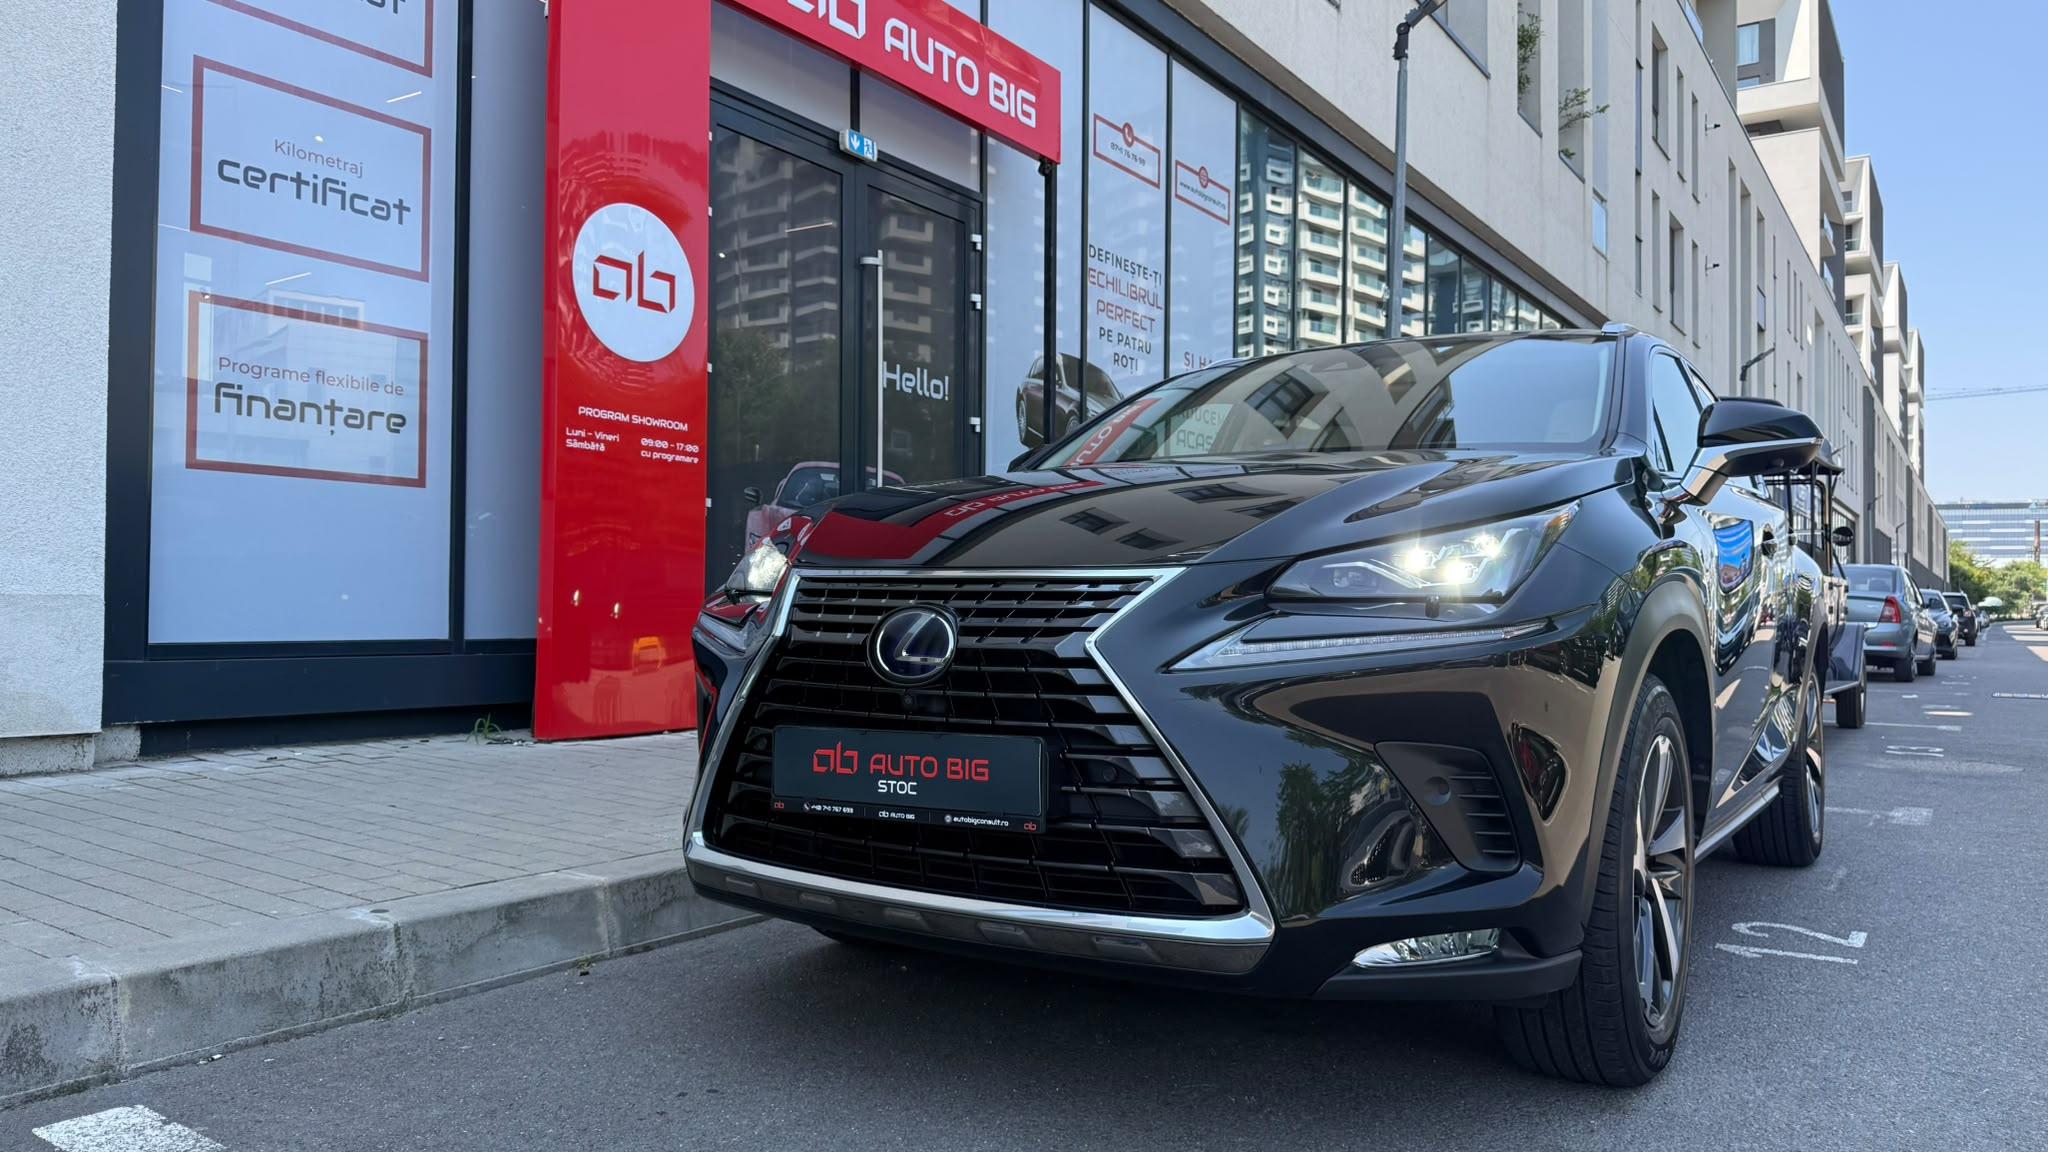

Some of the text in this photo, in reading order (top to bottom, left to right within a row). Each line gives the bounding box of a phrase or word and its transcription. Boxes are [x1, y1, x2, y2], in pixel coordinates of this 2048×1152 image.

[884, 17, 979, 97] AUTO
[988, 71, 1036, 129] BIG
[274, 139, 364, 179] Kilometraj
[217, 158, 411, 225] certificat
[1087, 267, 1163, 310] ECHILIBRUL
[1096, 298, 1156, 333] PERFECT
[1099, 326, 1151, 355] PE PATRU
[218, 356, 405, 396] Programe flexibile de
[882, 360, 949, 401] Hello!
[214, 381, 407, 436] finanțare
[578, 406, 688, 432] PROGRAM SHOWROOM
[566, 427, 586, 438] Luni
[594, 431, 620, 443] Vineri
[641, 438, 669, 449] 09:00
[676, 442, 699, 453] 17:00
[1176, 429, 1213, 452] ACAS
[641, 450, 699, 464] cu programare
[869, 753, 938, 778] AUTO
[946, 757, 990, 782] BIG
[877, 780, 918, 795] STOC
[953, 815, 1009, 827] autobigconsult.ro
